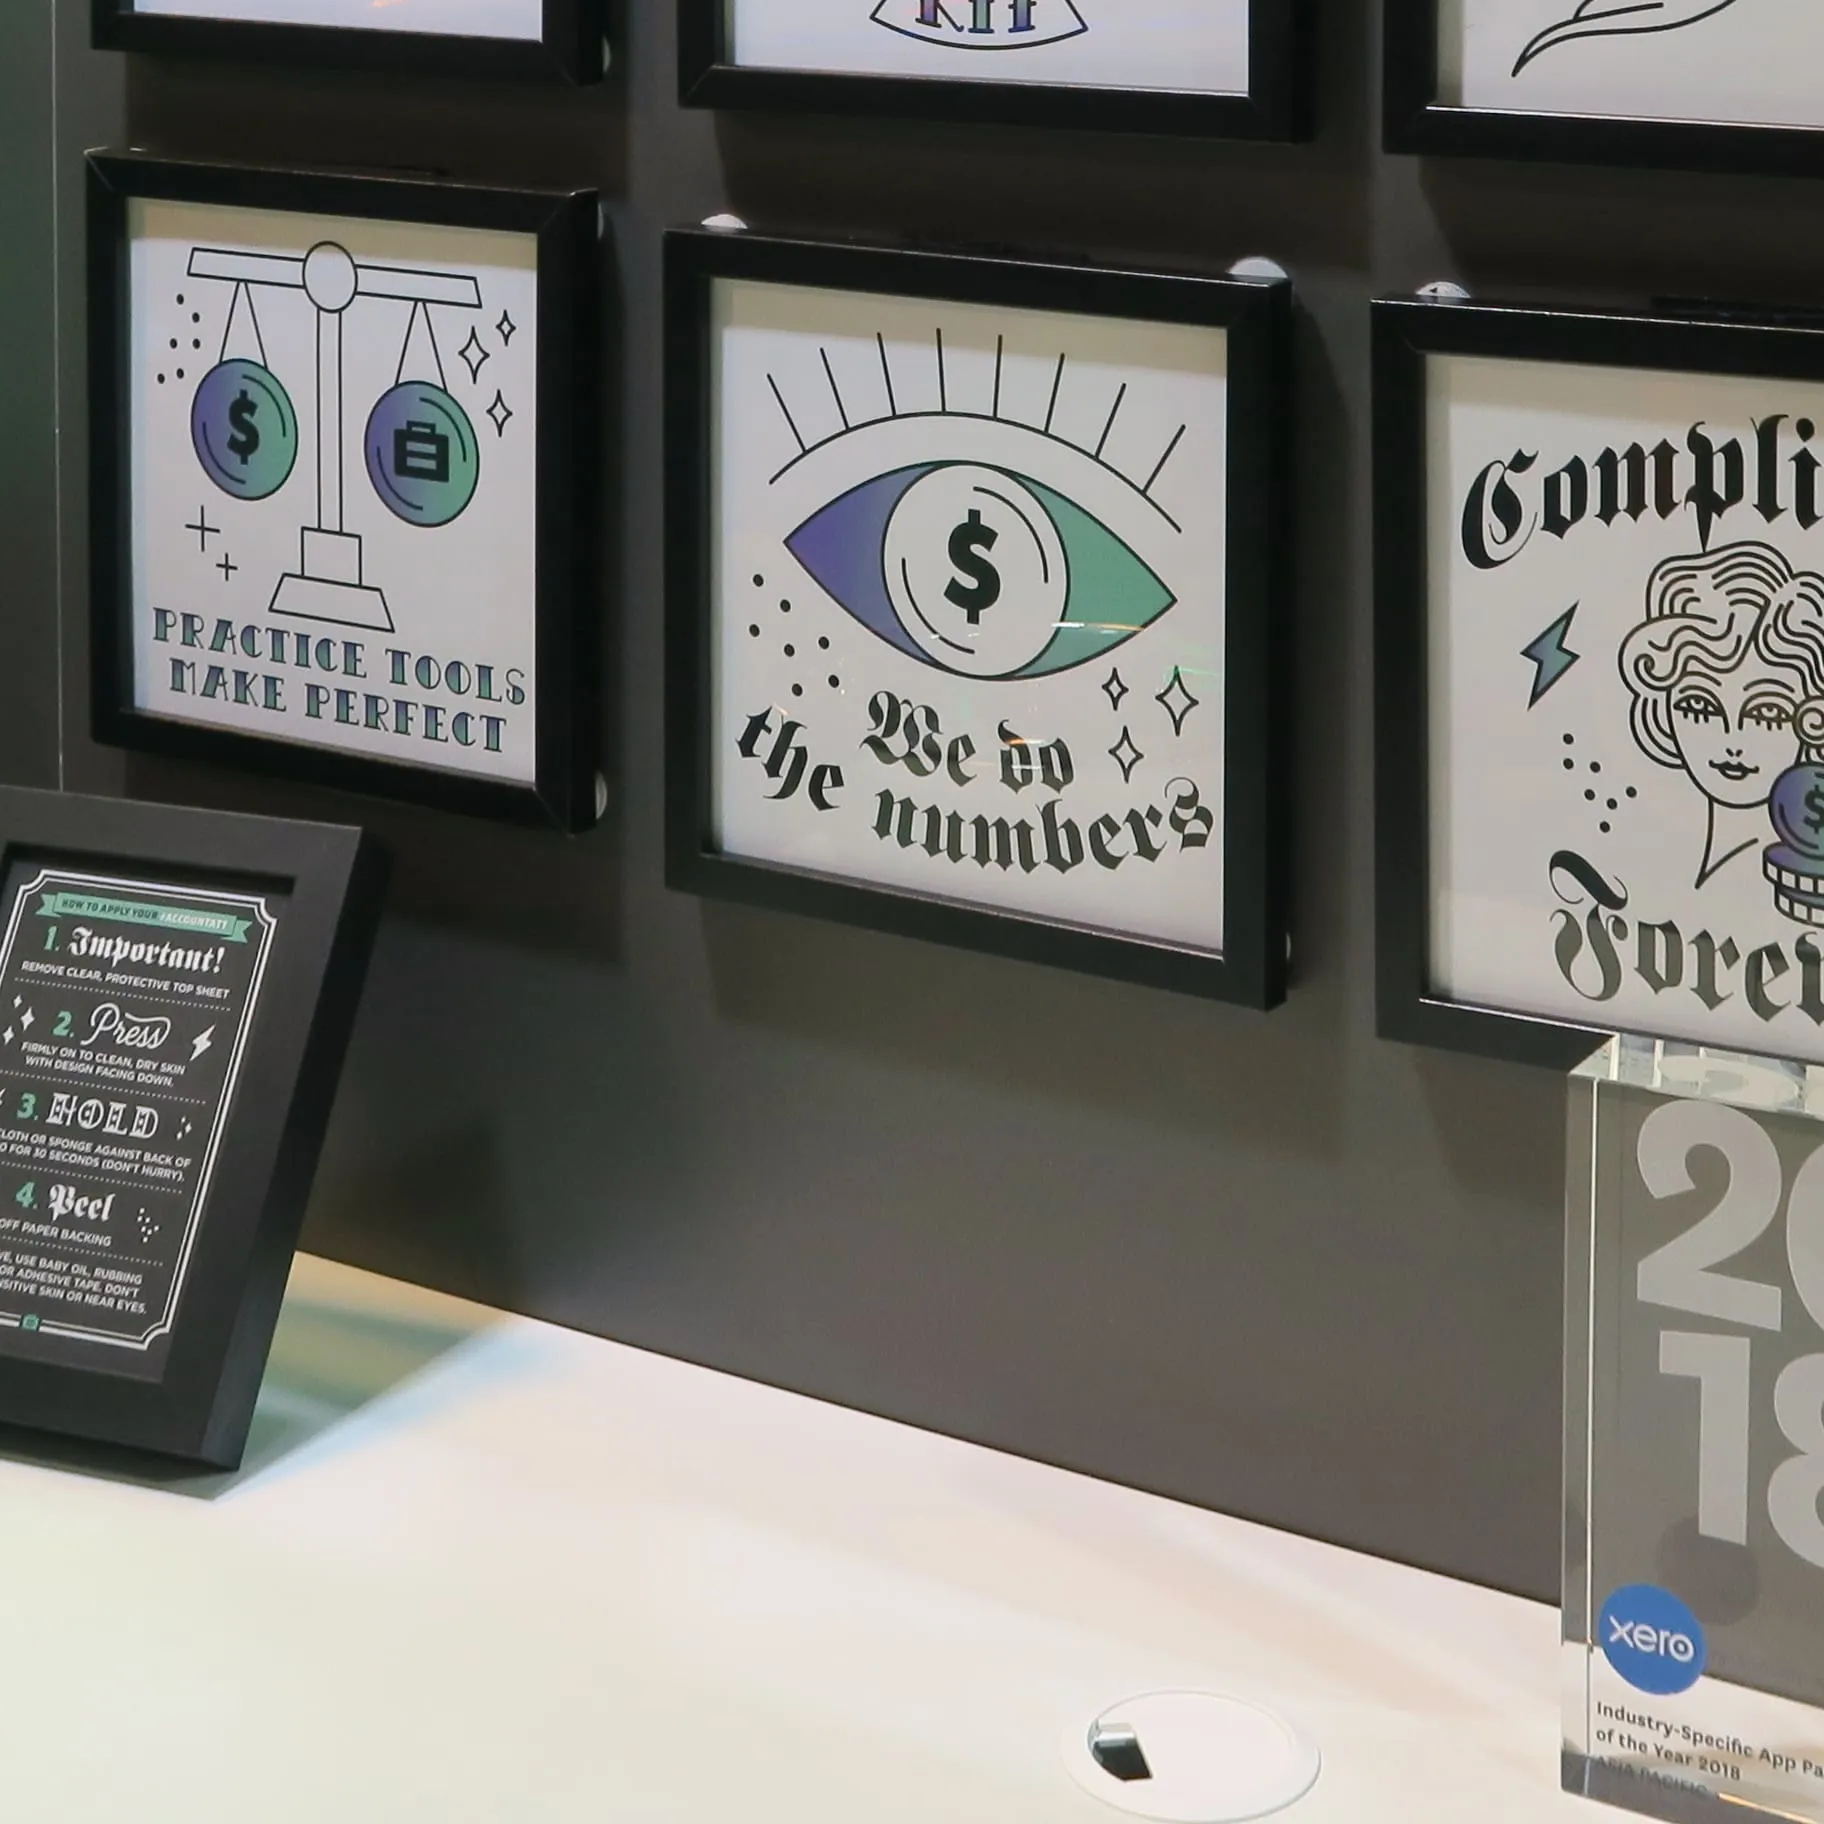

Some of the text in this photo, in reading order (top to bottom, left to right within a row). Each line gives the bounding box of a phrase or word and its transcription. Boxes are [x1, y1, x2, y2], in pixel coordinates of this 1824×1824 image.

[152, 607, 526, 706] PRACTICE TOOLS
[169, 658, 507, 754] MAKE PERFECT
[859, 689, 1074, 793] We do
[735, 705, 1214, 875] the numbers
[61, 899, 83, 909] HOW
[86, 902, 99, 911] TO
[100, 904, 129, 916] APPLY
[132, 909, 158, 920] YOUR
[44, 926, 225, 974] 1. Important!
[22, 961, 230, 999] REMOVE CLEAR, PROTECTIVE TOP SHEET
[52, 1003, 171, 1049] 2. Press
[21, 1041, 185, 1075] FIRMLY ON TO CLEAN, DRY SKIN
[26, 1056, 174, 1087] WITH DESIGN FACING DOWN.
[17, 1092, 159, 1139] 3. HOLD
[9, 1143, 31, 1155] FOR
[33, 1147, 47, 1158] 30
[49, 1150, 100, 1169] SECONDS
[102, 1158, 140, 1175] (DON'T
[30, 1133, 47, 1145] OR
[48, 1136, 93, 1153] SPONGE
[94, 1144, 142, 1159] AGAINST
[143, 1152, 173, 1166] BACK
[175, 1158, 192, 1168] OF
[15, 1182, 116, 1222] 4. Peel
[21, 1223, 60, 1238] PAPER
[61, 1230, 112, 1247] BACKING
[15, 1253, 37, 1265] USE
[39, 1257, 68, 1271] BABY
[71, 1264, 91, 1277] OIL,
[94, 1268, 143, 1285] RUBBING
[16, 1267, 73, 1287] ADHESIVE
[104, 1283, 140, 1298] DON'T
[39, 1287, 64, 1299] SKIN
[66, 1291, 82, 1302] OR
[84, 1294, 114, 1307] NEAR
[116, 1299, 147, 1314] EYES.
[1609, 1615, 1695, 1662] xero
[1596, 1729, 1741, 1781] of the Year 2018
[1597, 1701, 1753, 1759] Industry-Specific
[1759, 1747, 1796, 1772] App
